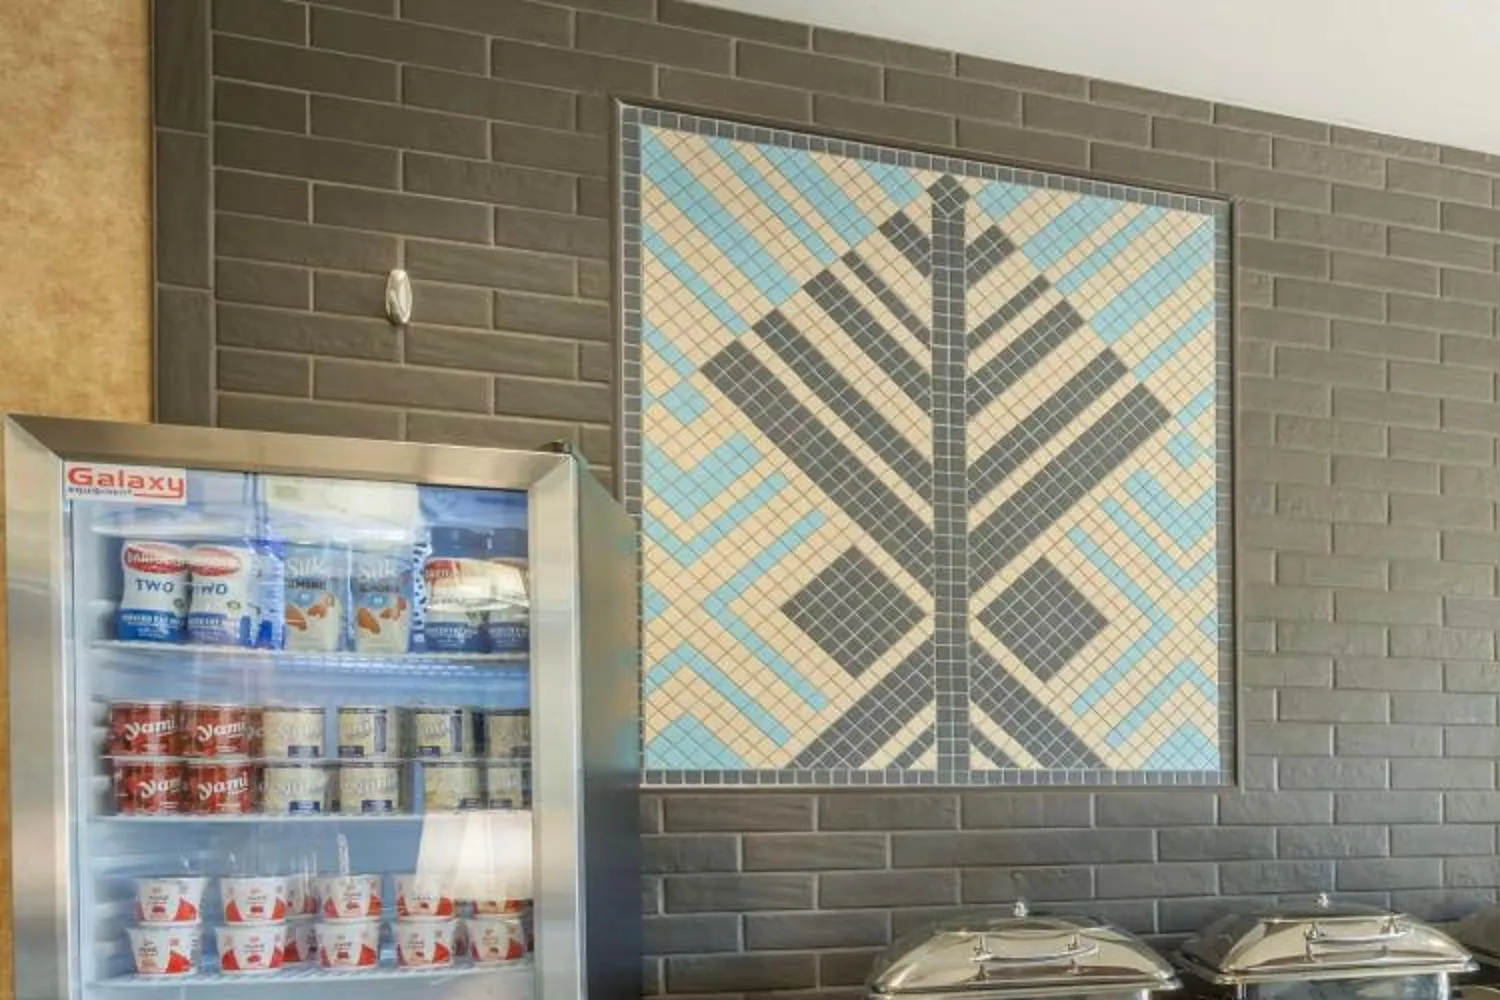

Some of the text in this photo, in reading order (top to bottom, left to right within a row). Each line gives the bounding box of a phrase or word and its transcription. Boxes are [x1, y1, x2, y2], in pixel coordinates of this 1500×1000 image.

[67, 466, 185, 498] Galaxy
[135, 578, 175, 593] TWO
[197, 771, 249, 800] yami
